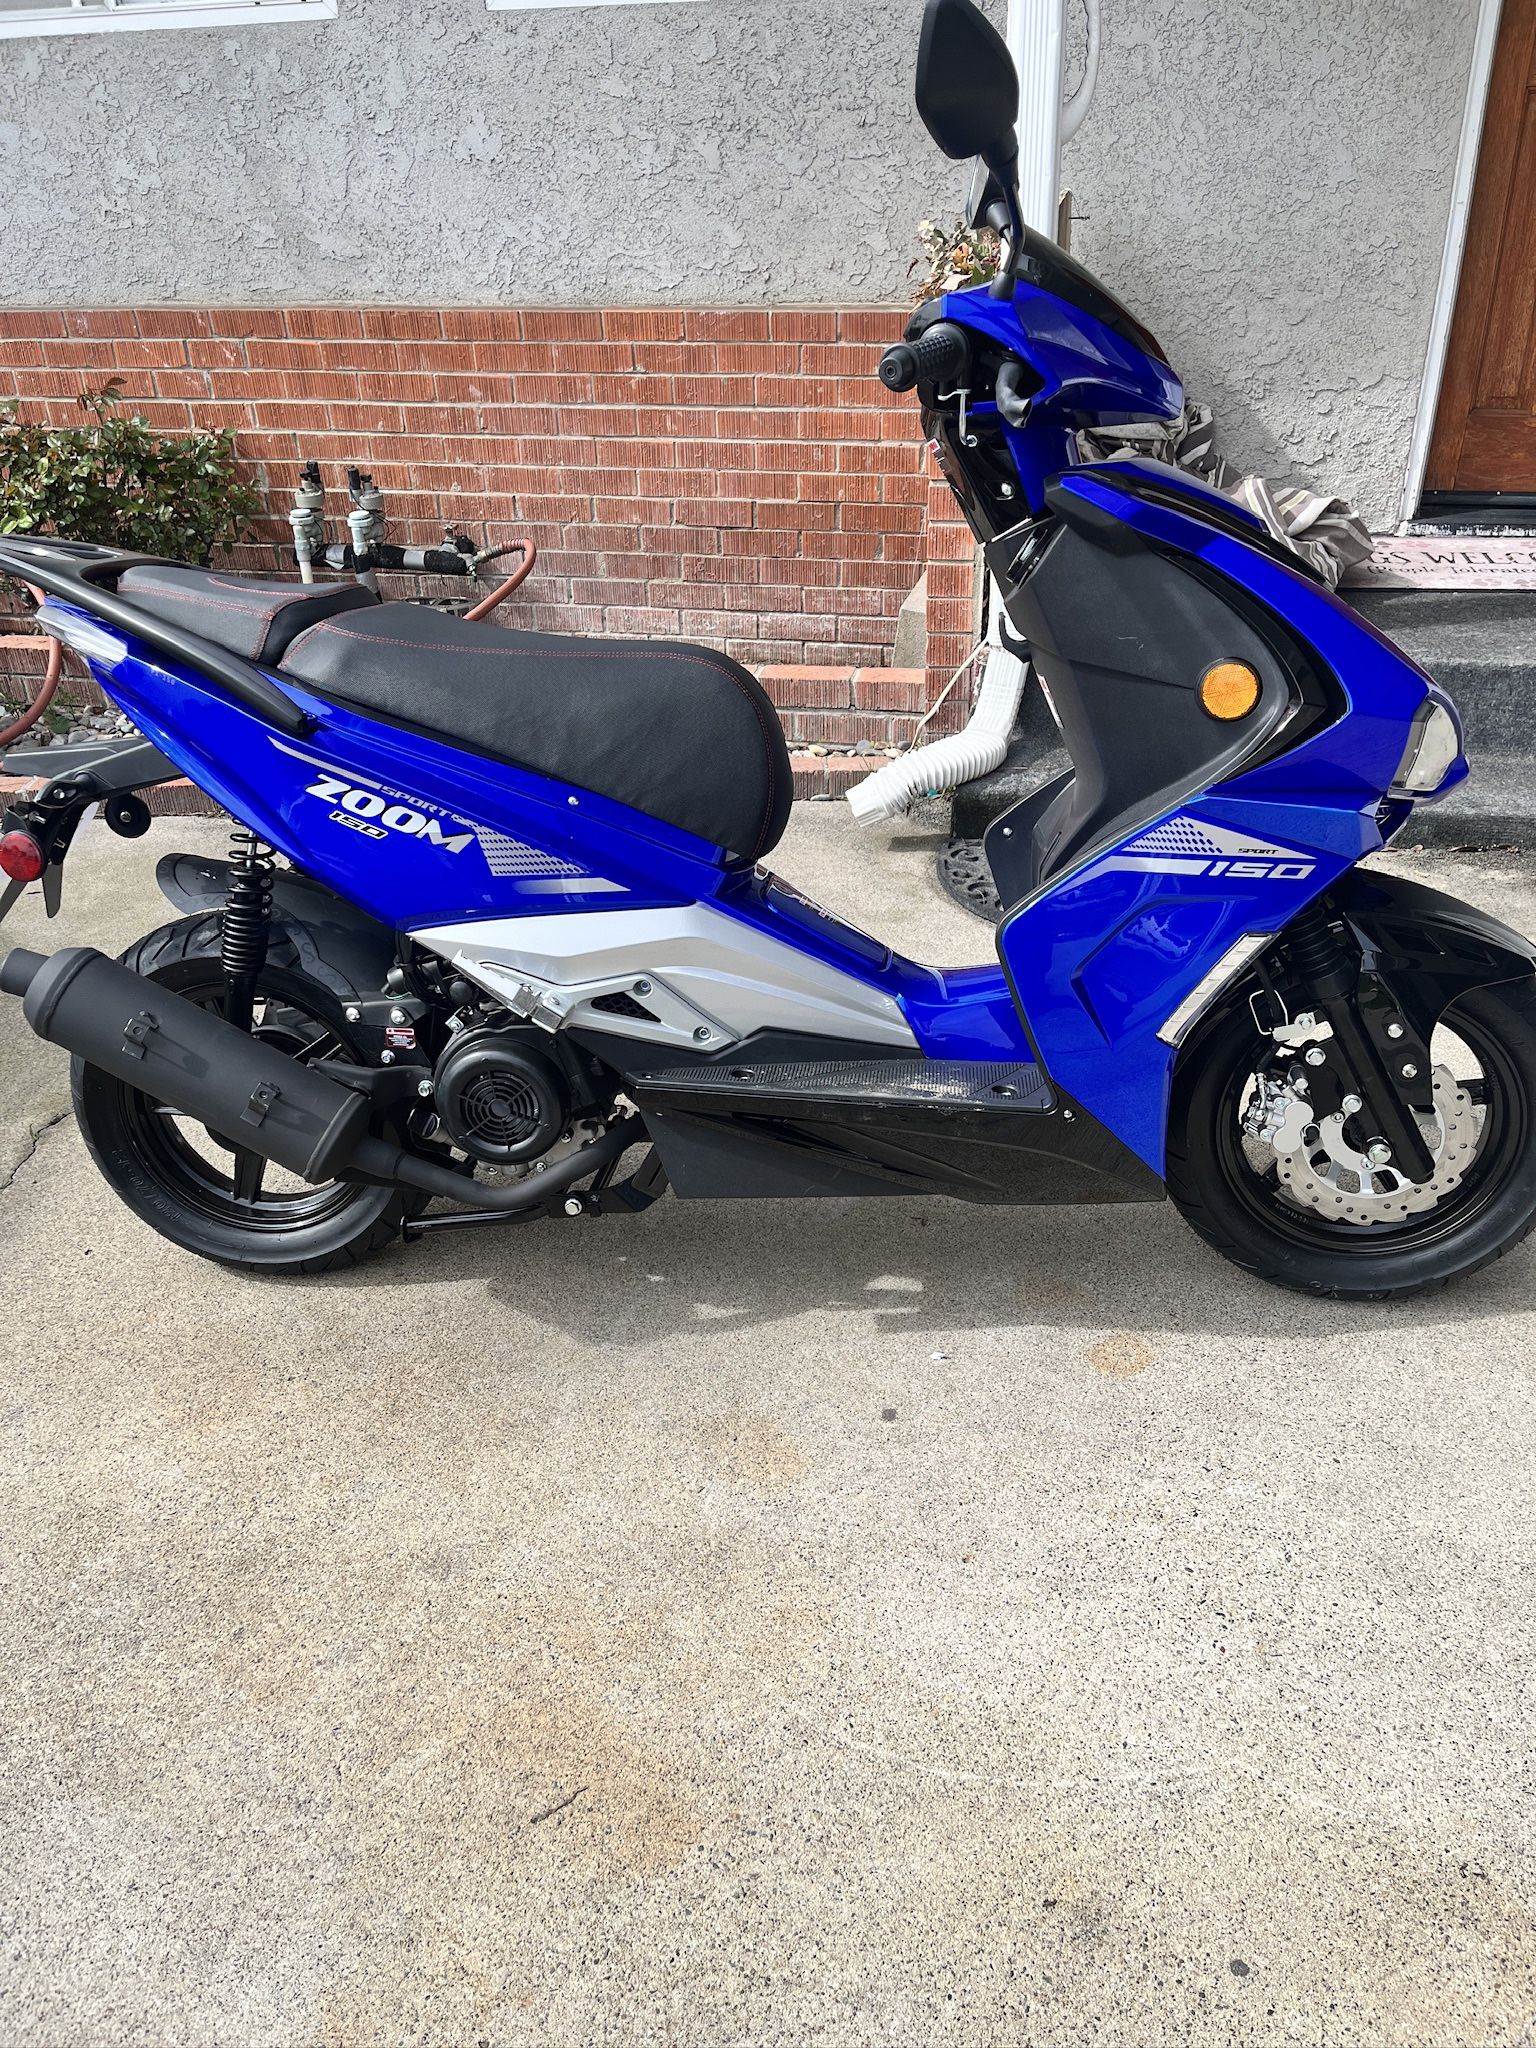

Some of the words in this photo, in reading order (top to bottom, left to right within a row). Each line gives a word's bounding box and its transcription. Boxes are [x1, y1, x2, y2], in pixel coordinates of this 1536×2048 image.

[305, 774, 476, 854] ZOOM
[381, 785, 455, 818] SPORT
[329, 810, 389, 840] 150
[1208, 862, 1317, 880] 150
